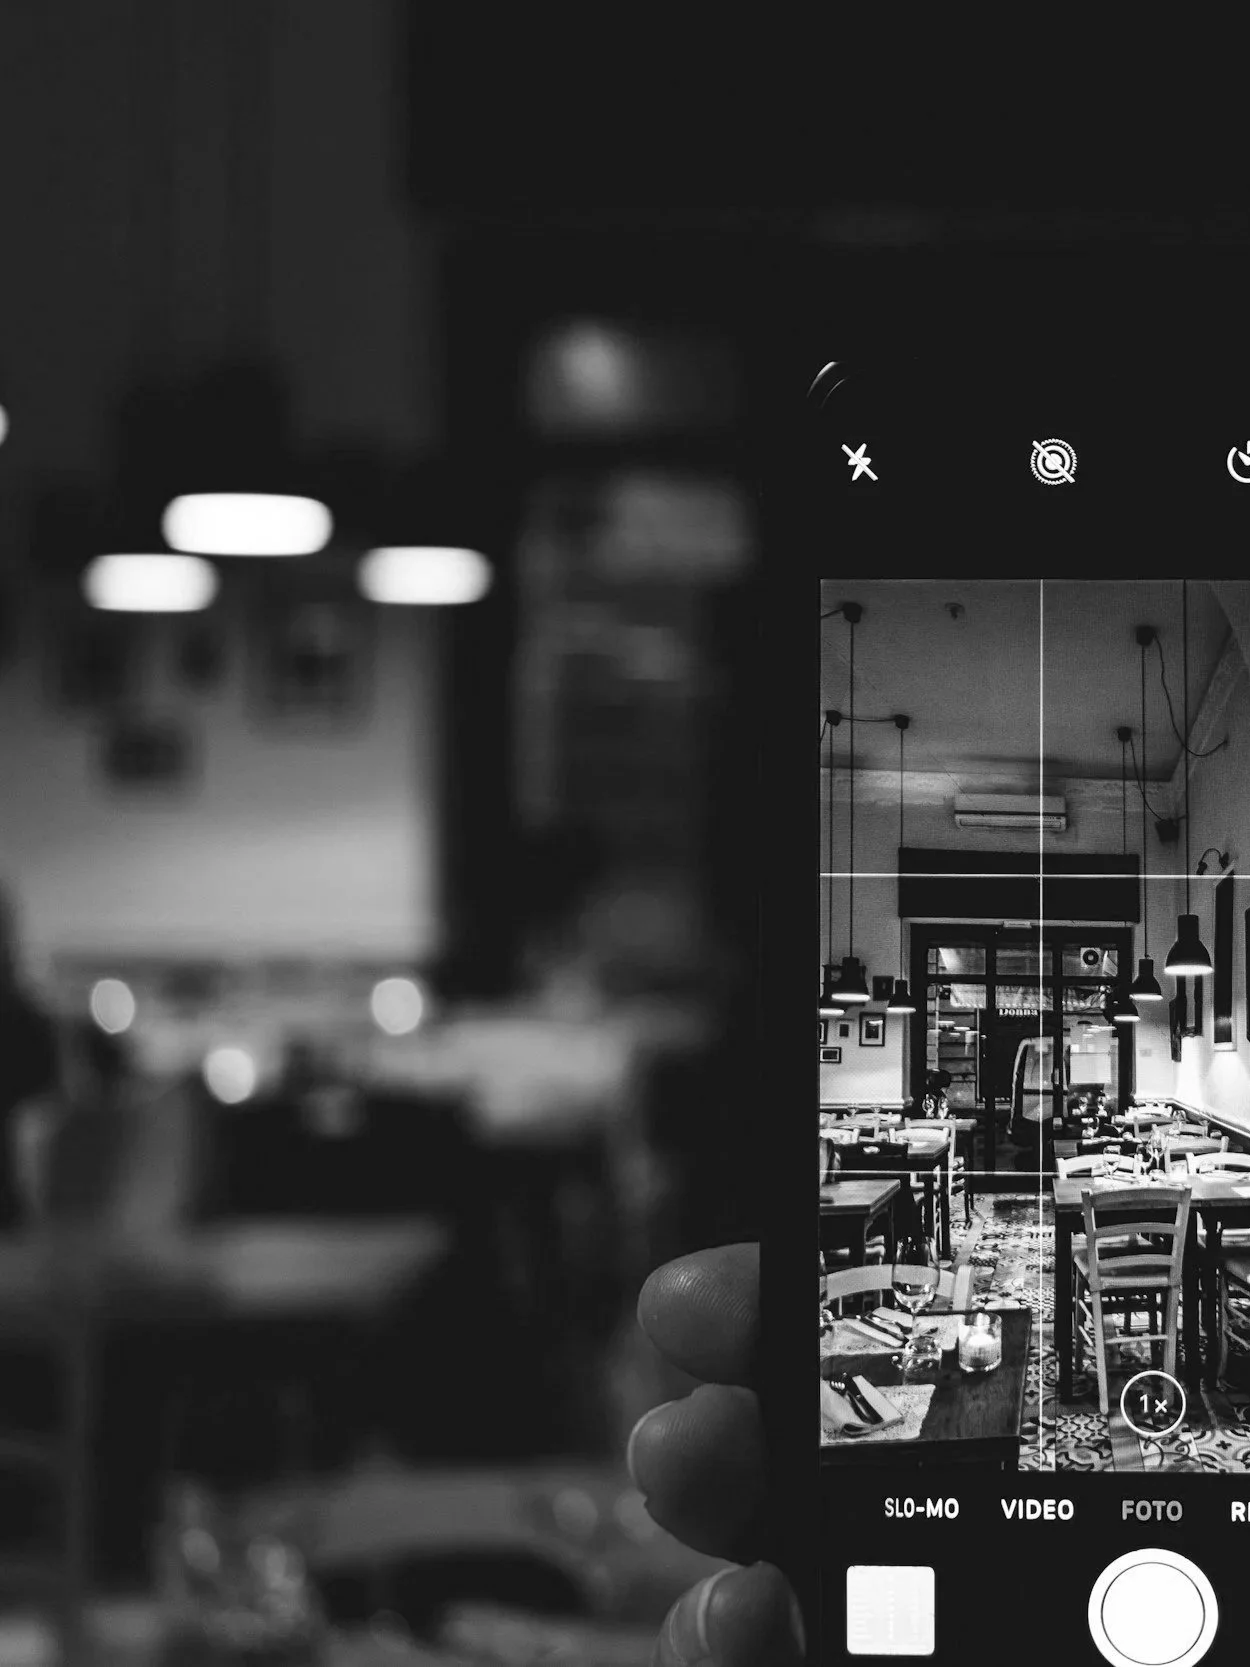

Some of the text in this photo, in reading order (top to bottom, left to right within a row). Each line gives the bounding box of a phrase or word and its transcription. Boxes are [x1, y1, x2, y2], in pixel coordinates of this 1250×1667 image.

[884, 1497, 960, 1520] SLO-MO
[1001, 1498, 1075, 1521] VIDEO
[1121, 1499, 1183, 1522] FOTO
